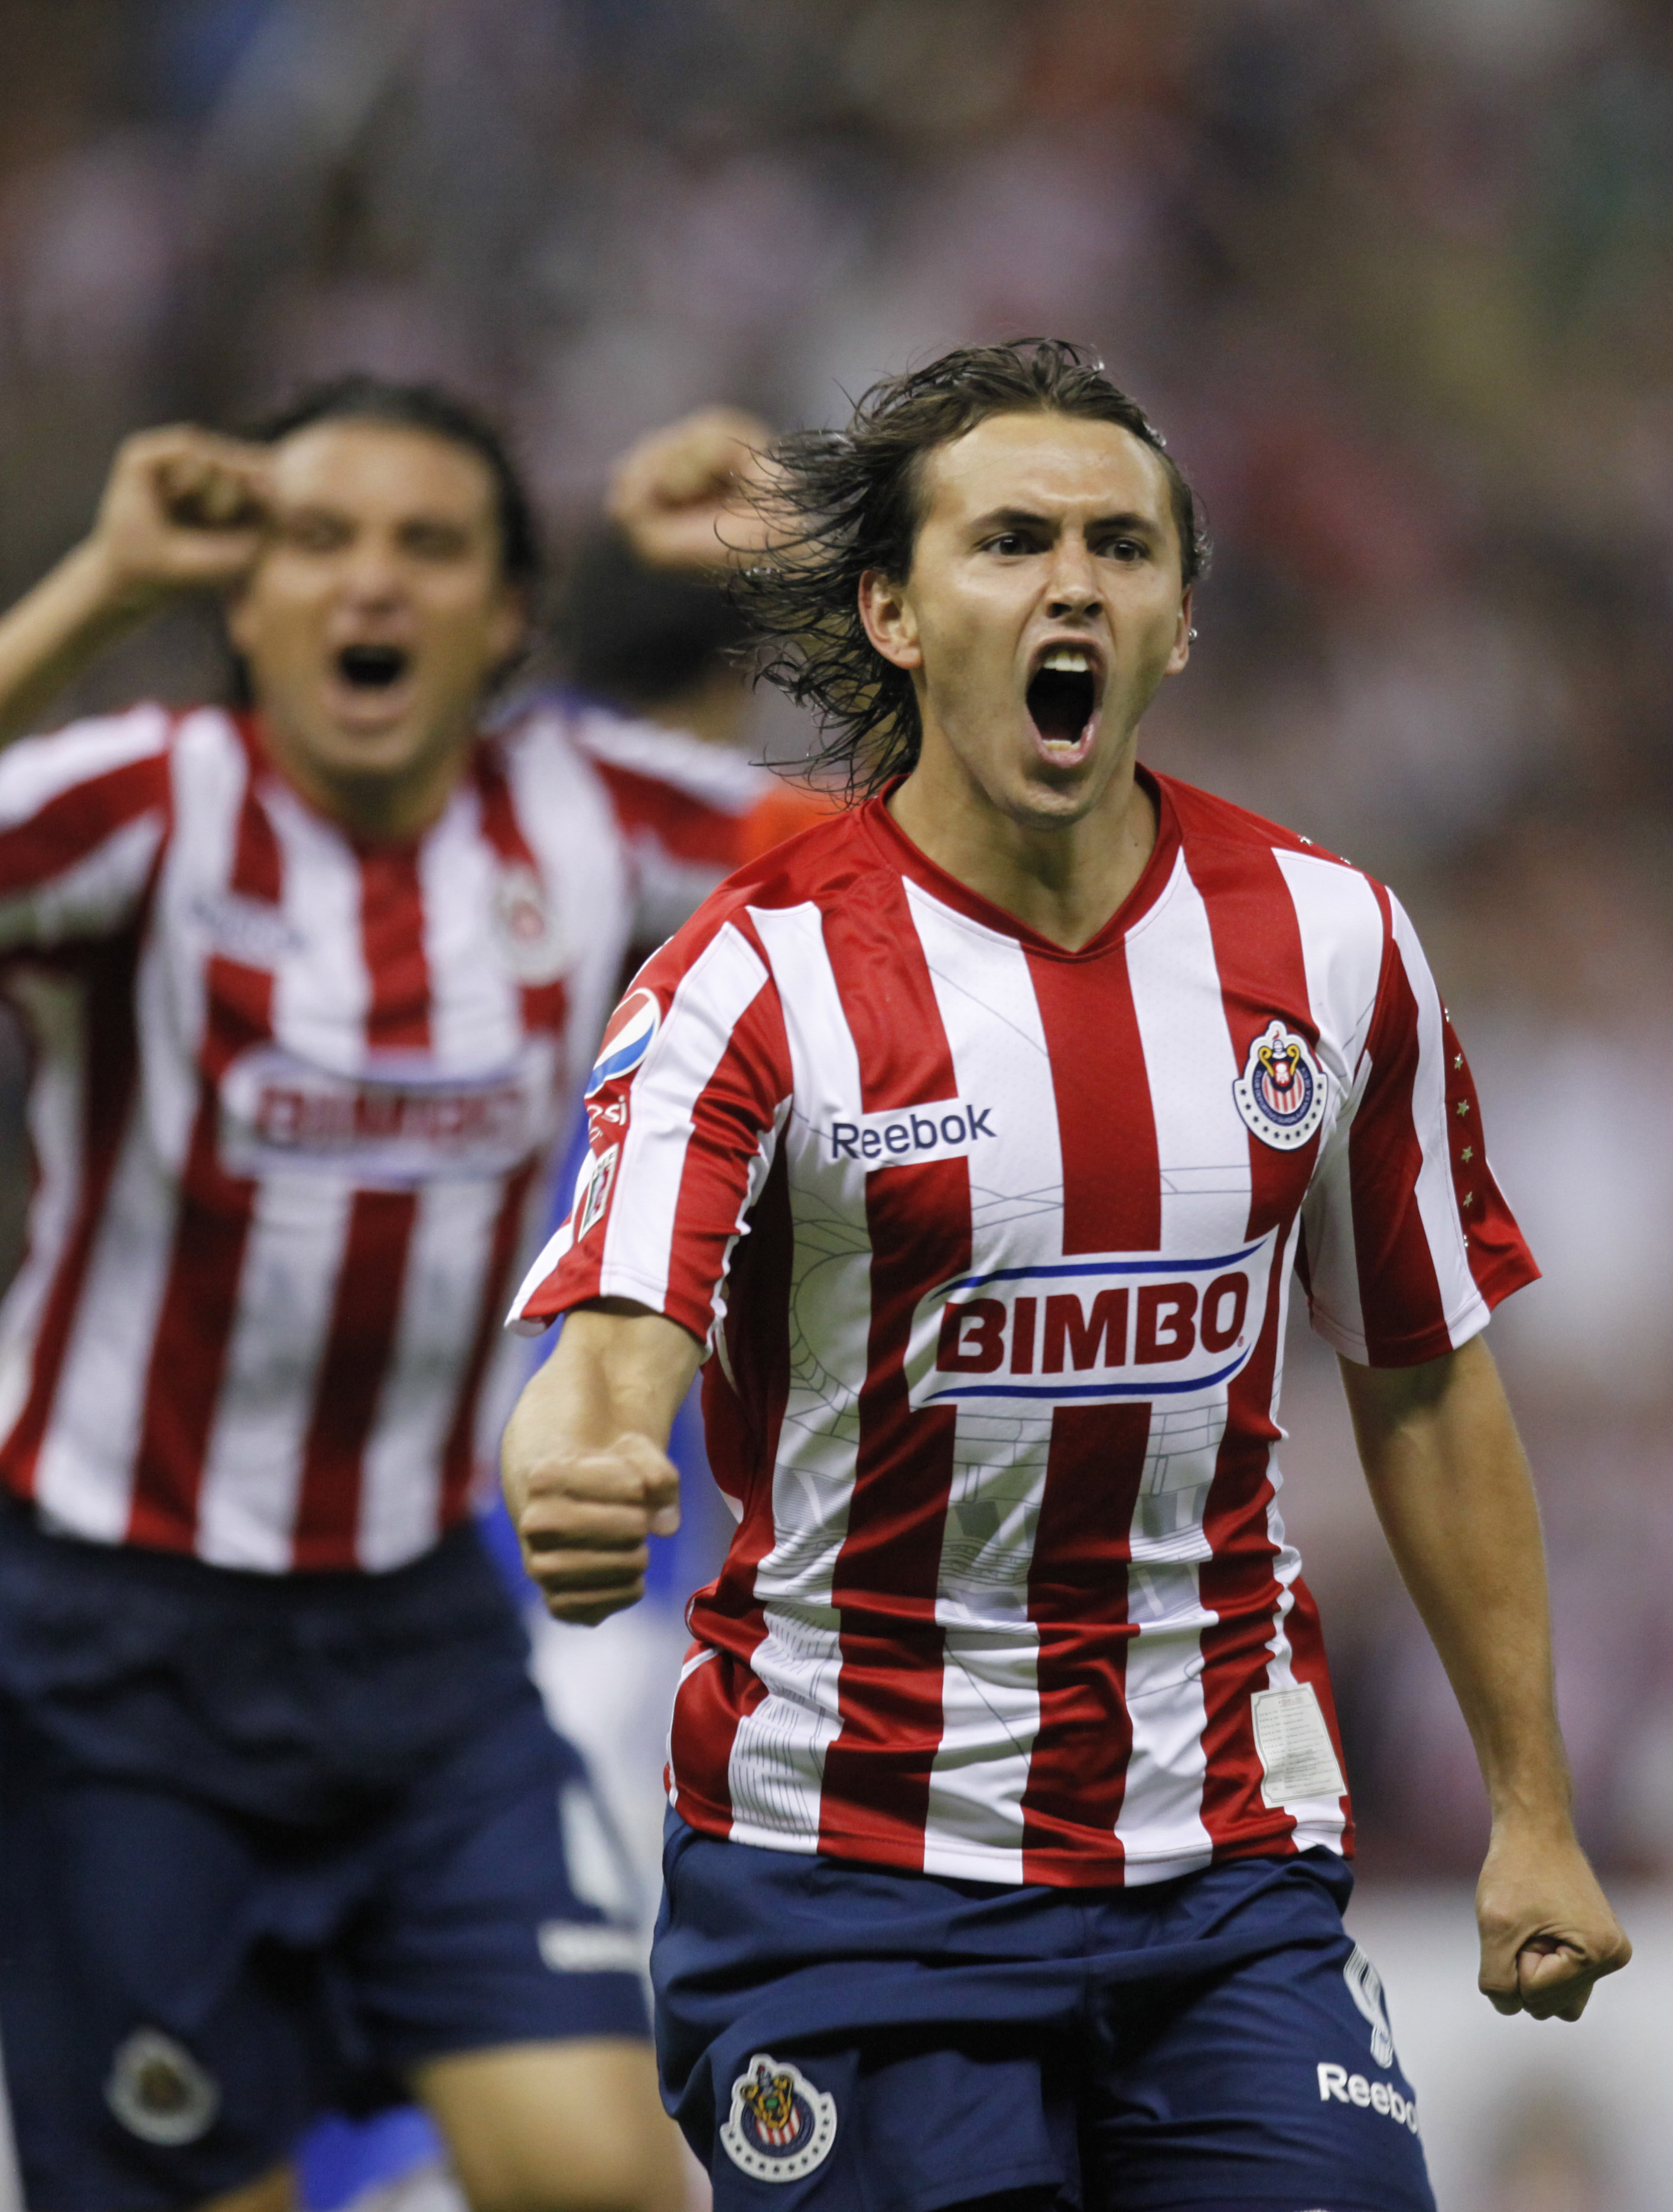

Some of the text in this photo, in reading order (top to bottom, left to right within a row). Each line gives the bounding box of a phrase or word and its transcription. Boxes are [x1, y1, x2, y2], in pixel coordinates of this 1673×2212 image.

[832, 1104, 997, 1159] Reebok
[936, 1271, 1249, 1375] BIMBO
[1317, 2063, 1418, 2135] Reebo
